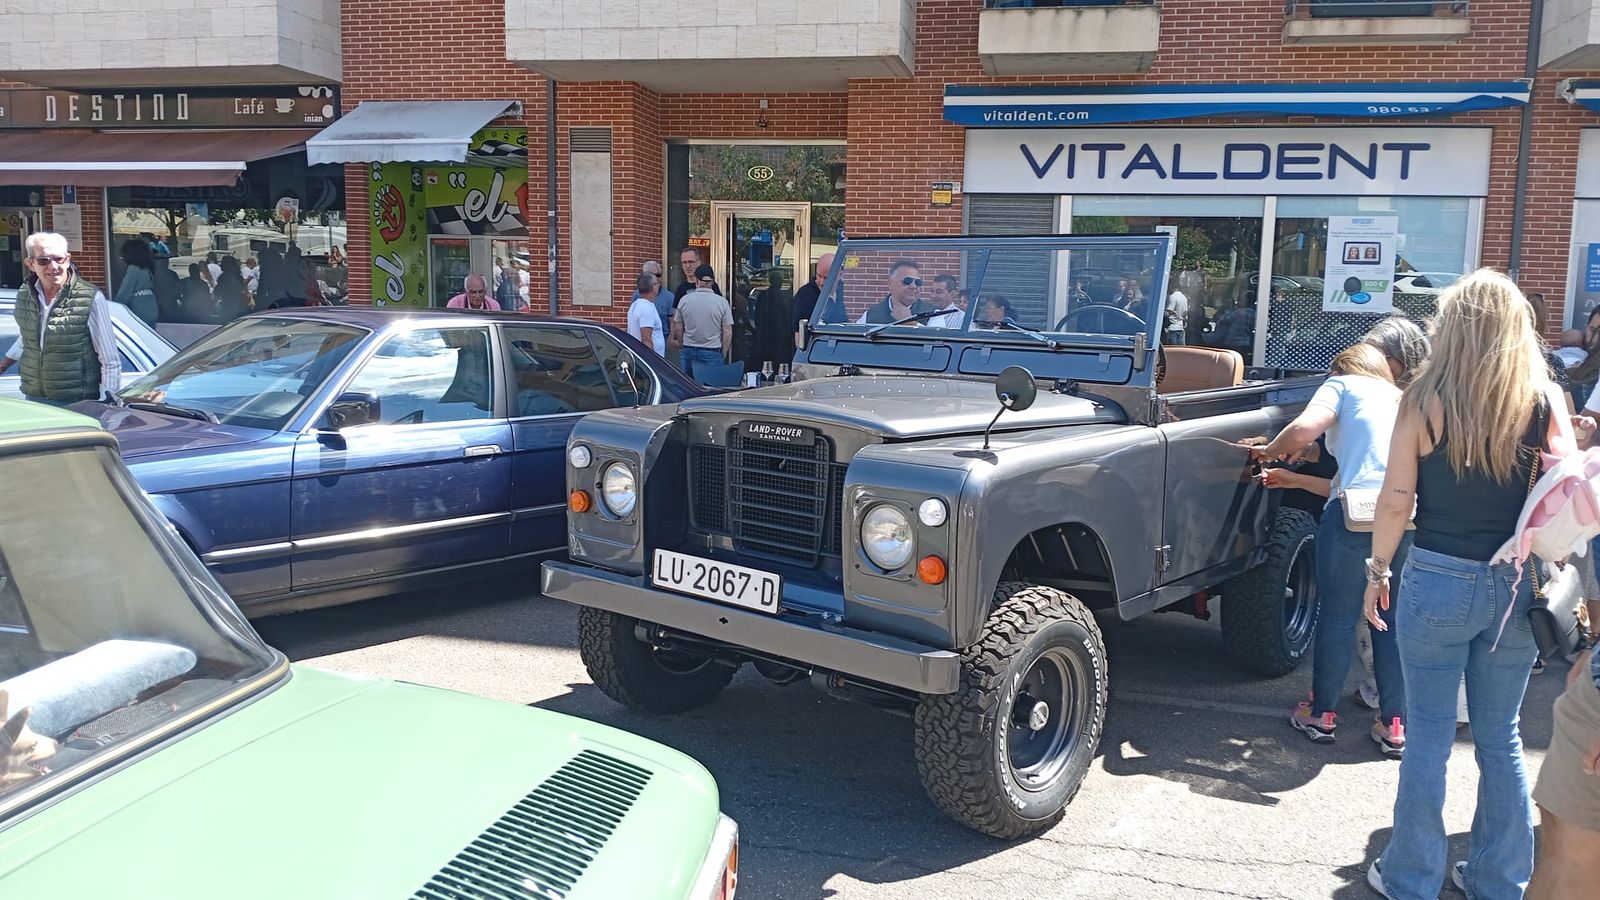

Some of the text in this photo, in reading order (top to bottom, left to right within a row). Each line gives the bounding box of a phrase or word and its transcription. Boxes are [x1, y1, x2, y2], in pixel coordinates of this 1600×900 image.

[45, 93, 189, 122] DESTINO
[234, 97, 264, 114] Café
[1367, 105, 1401, 114] 980
[983, 110, 1089, 121] vitaldent.com
[1019, 142, 1431, 180] VITALDENT
[753, 168, 768, 179] 55
[749, 424, 802, 438] LAND-ROVER
[759, 433, 791, 442] SANTANA
